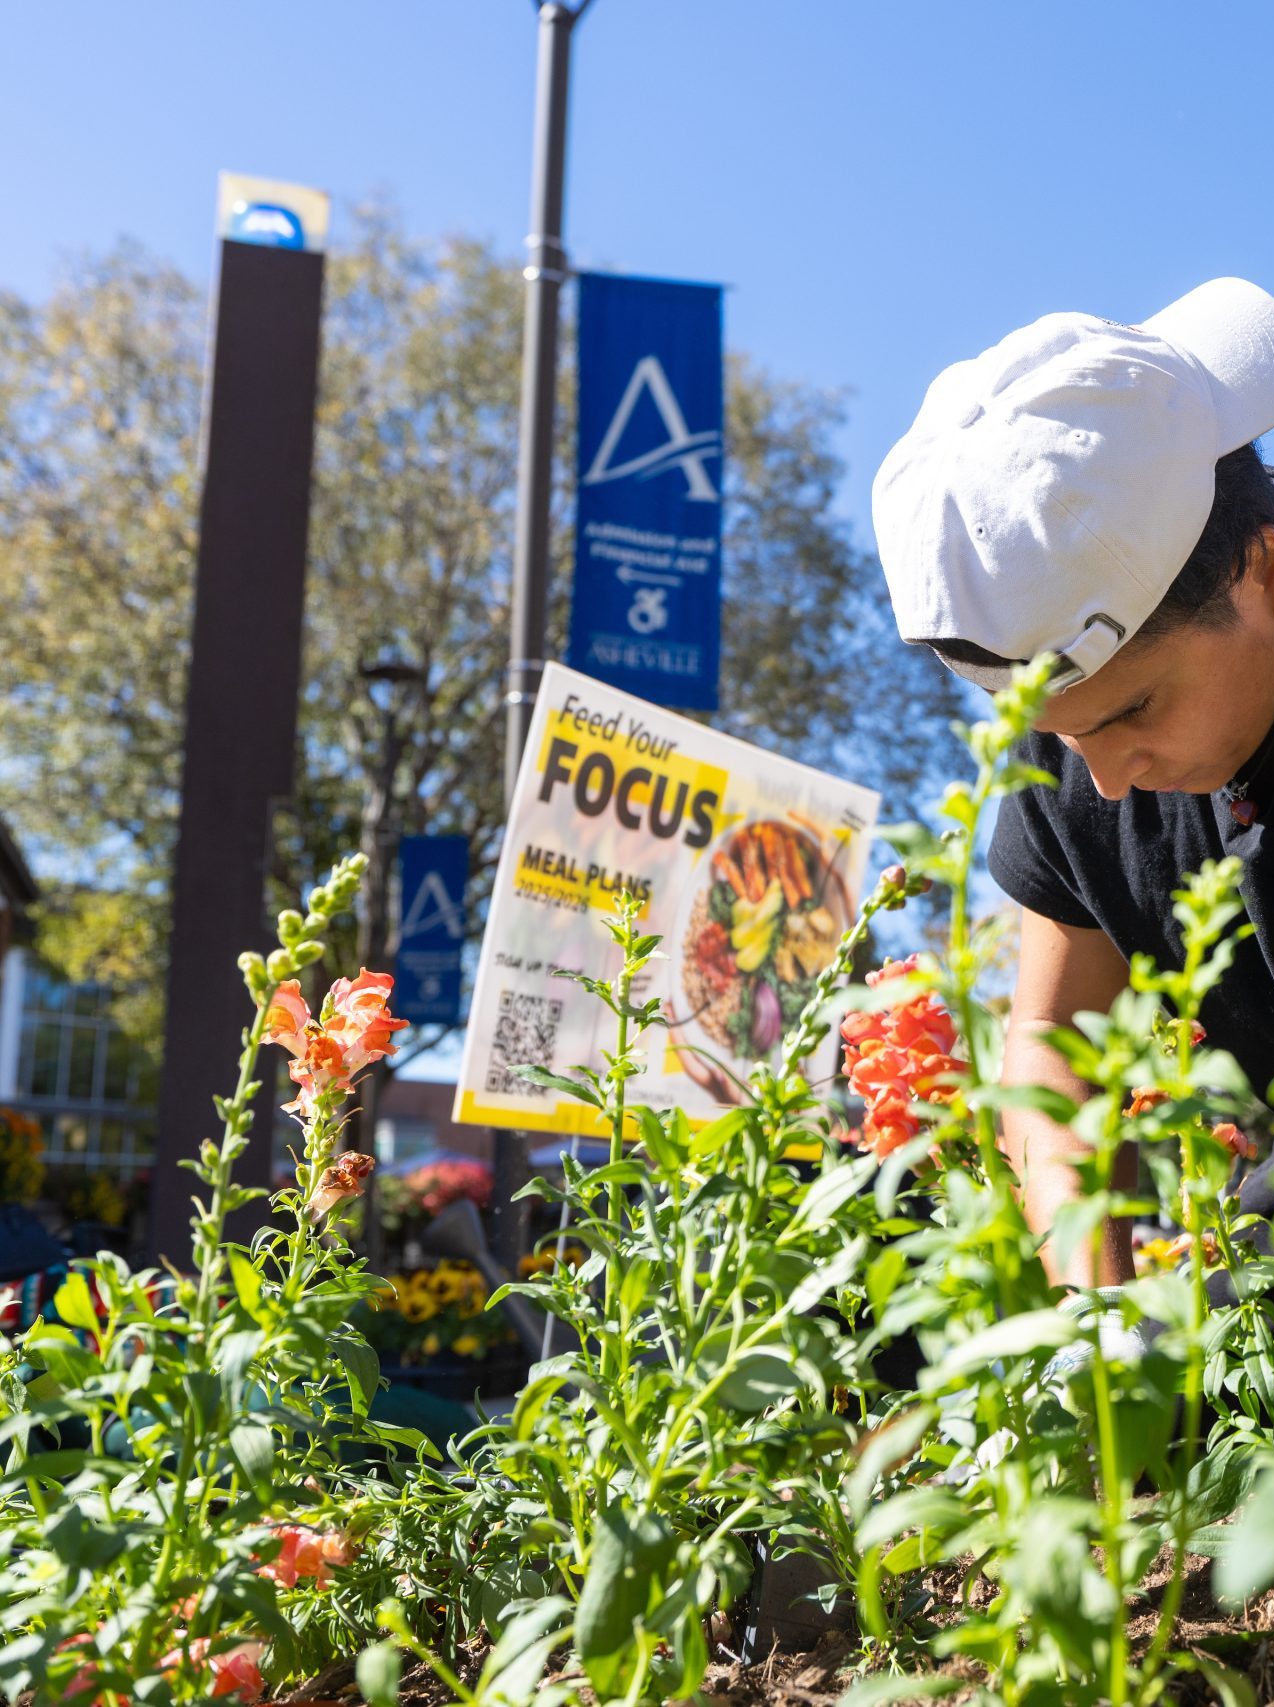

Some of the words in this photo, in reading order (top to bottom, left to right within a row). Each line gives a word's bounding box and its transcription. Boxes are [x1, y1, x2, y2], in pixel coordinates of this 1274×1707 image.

[557, 693, 624, 743] Feed
[625, 718, 679, 762] Your
[538, 736, 720, 849] FOCUS
[514, 879, 590, 915] 2025/2026
[522, 843, 578, 884] MEAL
[584, 861, 652, 902] PLANS
